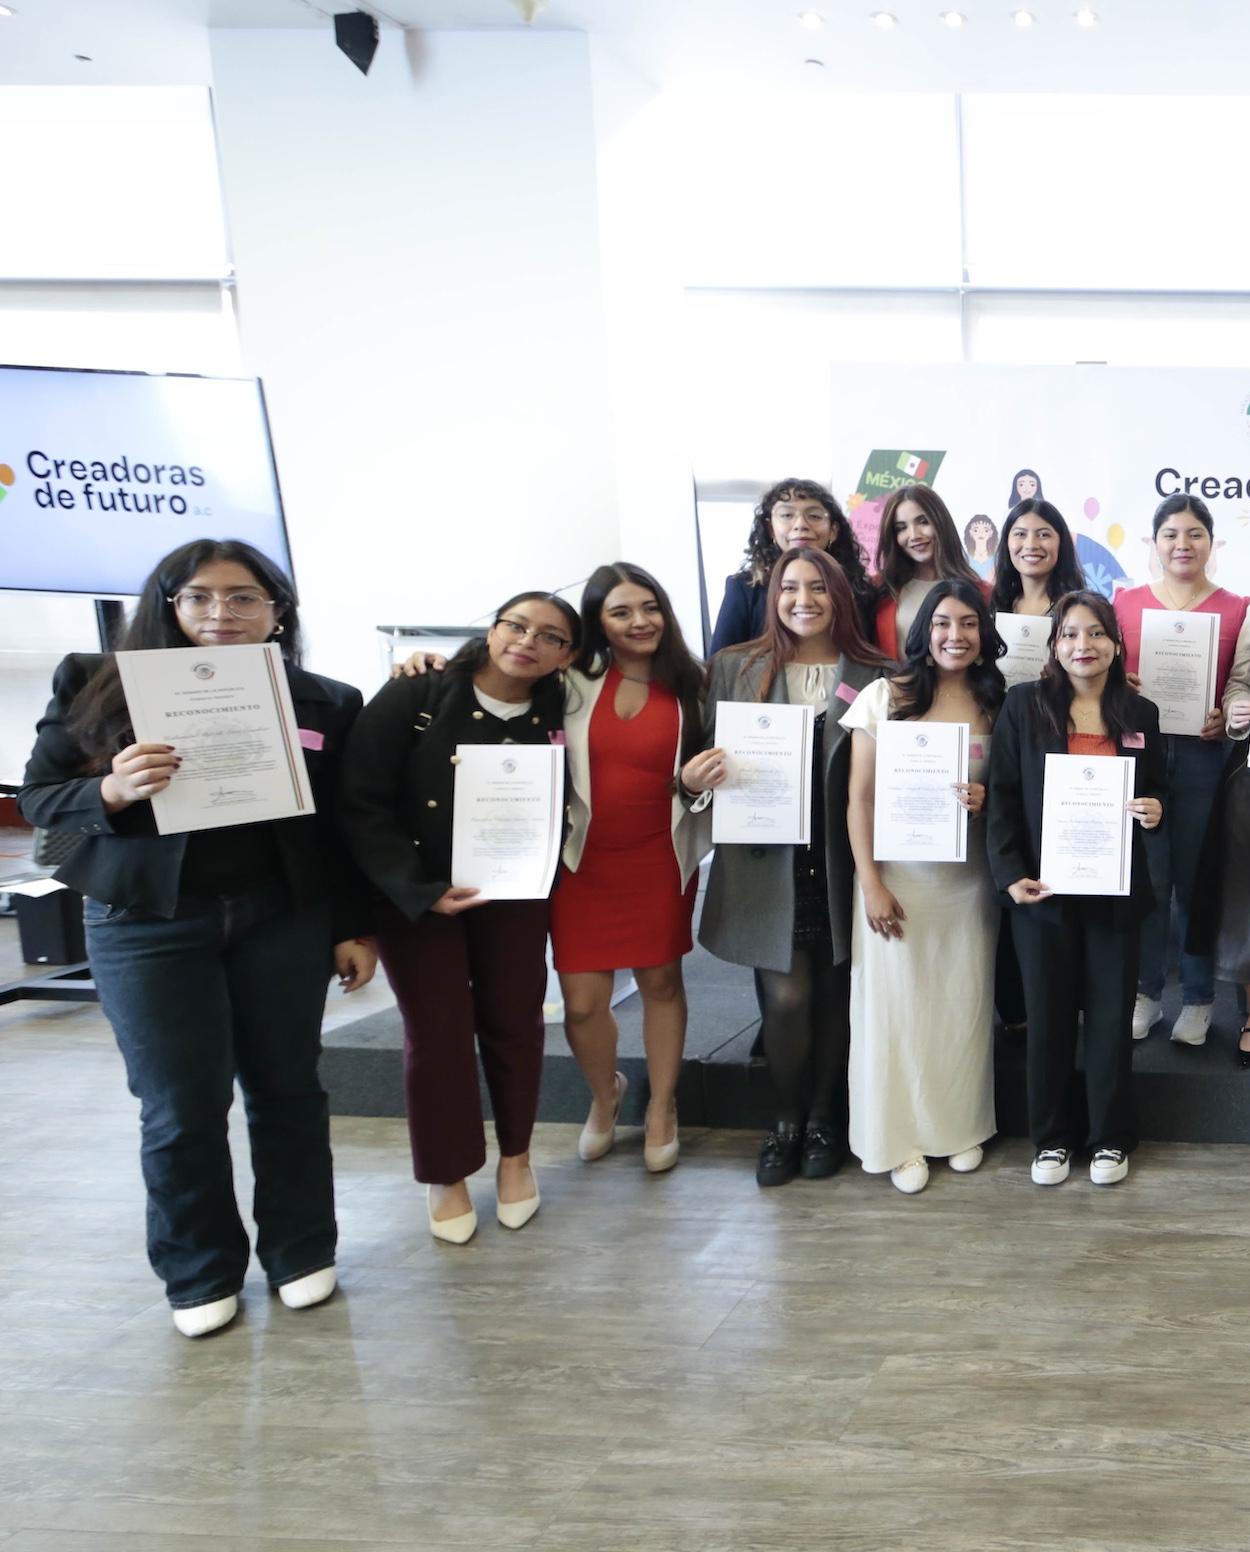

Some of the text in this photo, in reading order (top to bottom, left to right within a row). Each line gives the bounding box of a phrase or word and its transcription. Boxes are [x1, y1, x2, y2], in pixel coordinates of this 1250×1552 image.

[26, 450, 206, 487] Creadoras
[34, 481, 76, 510] de
[83, 483, 188, 515] futuro
[164, 704, 261, 718] RECONOCIMIENTO
